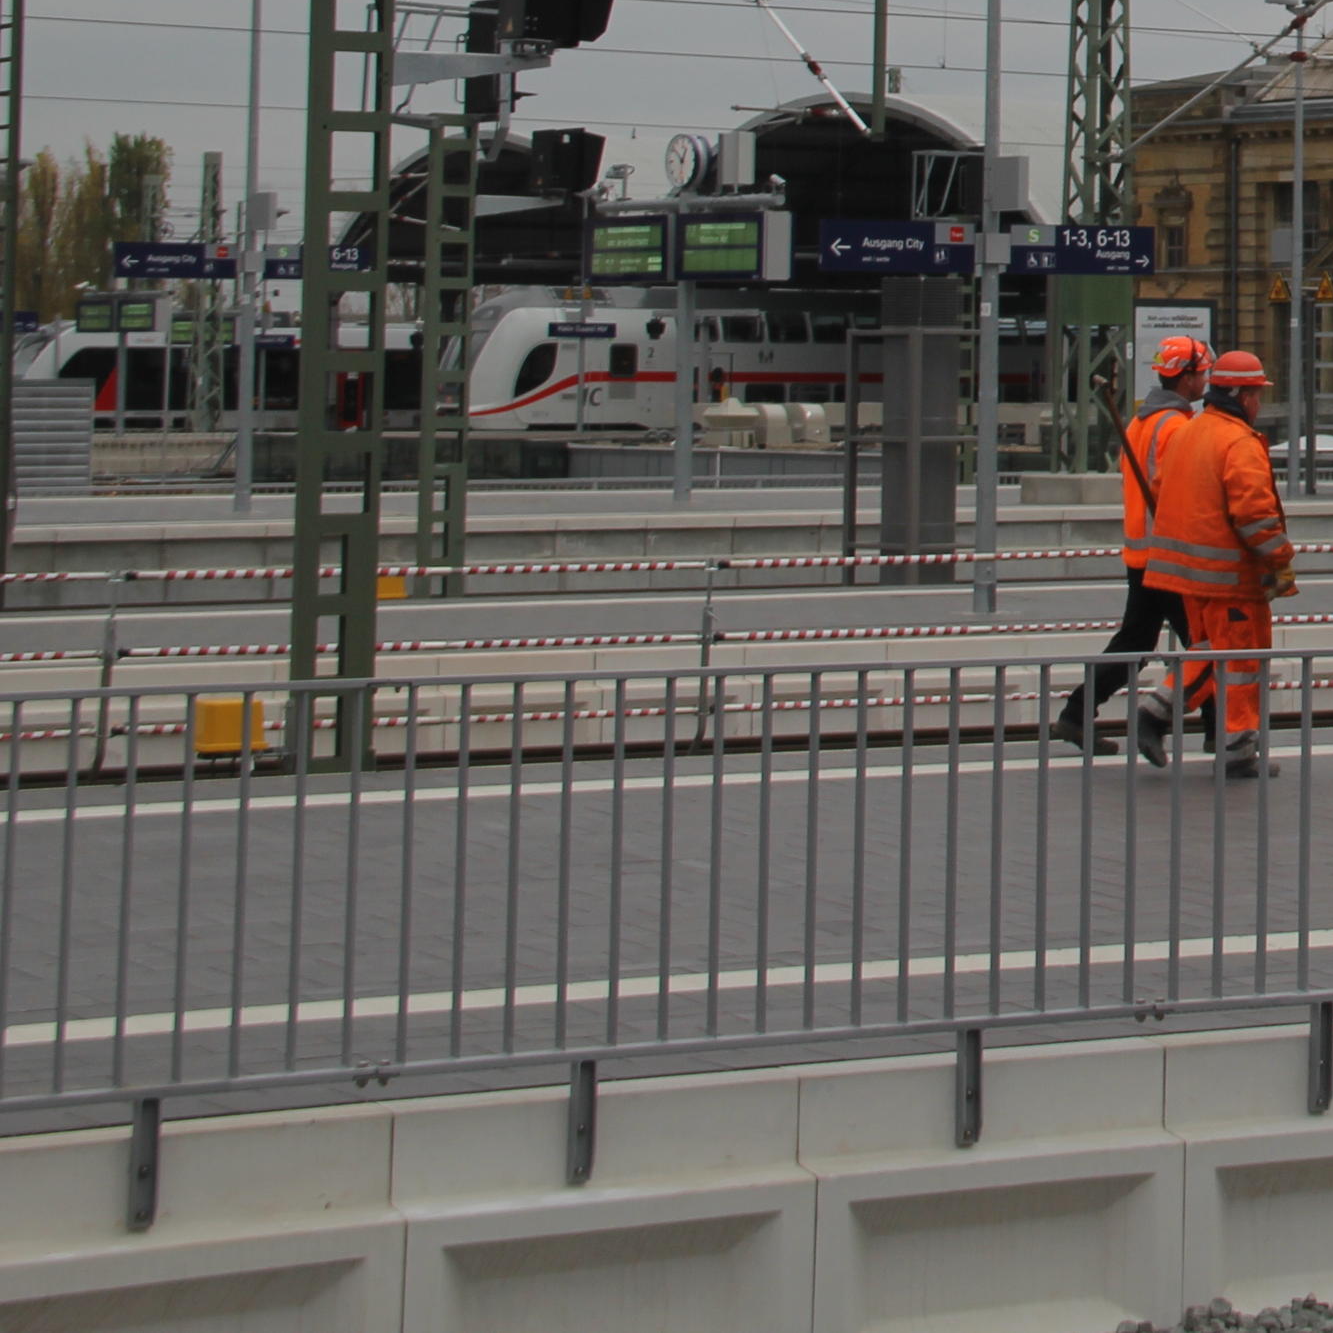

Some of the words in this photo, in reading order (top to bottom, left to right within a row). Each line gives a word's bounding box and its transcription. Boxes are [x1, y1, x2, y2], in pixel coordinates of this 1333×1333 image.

[862, 237, 904, 251] Ausgang
[906, 238, 925, 251] City
[1062, 229, 1092, 249] 1-3,
[1097, 229, 1131, 247] 6-13
[1096, 249, 1131, 260] Ausgang
[647, 347, 655, 359] 2
